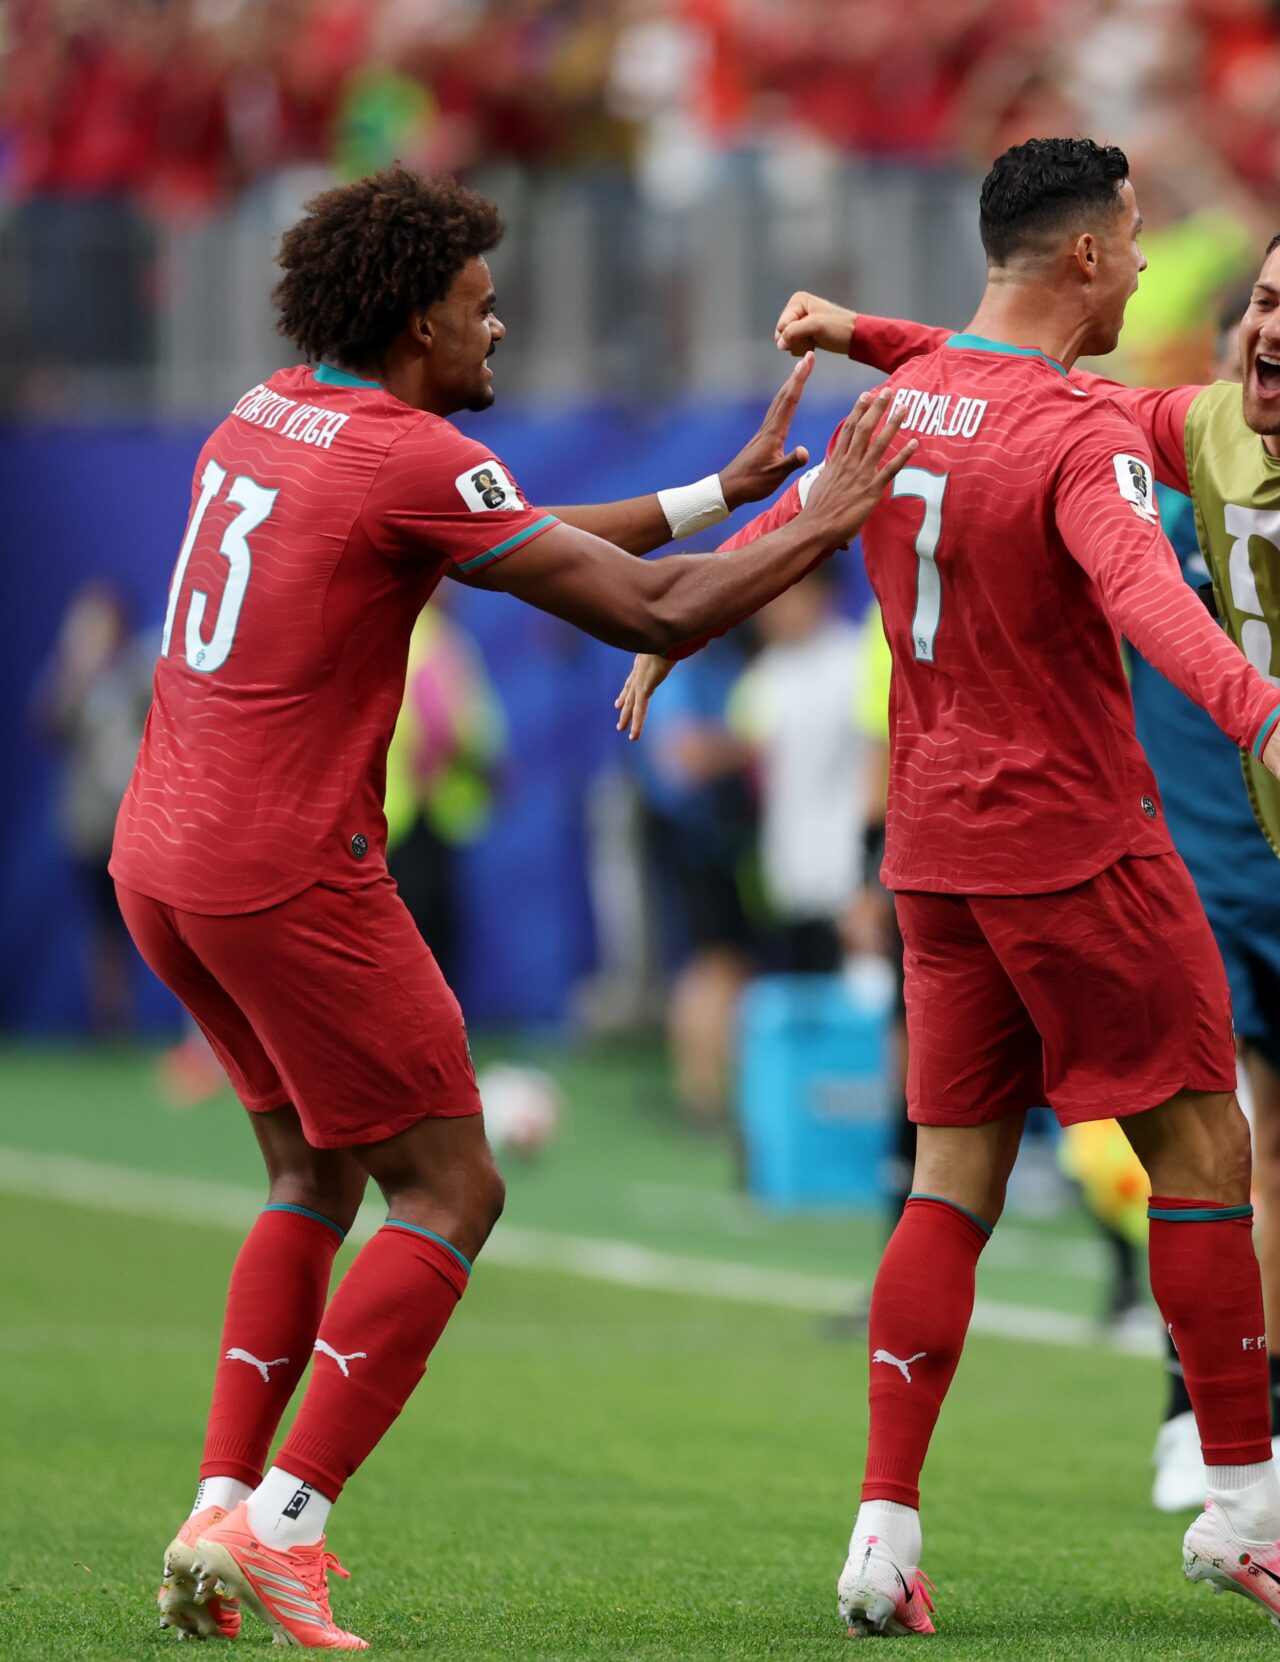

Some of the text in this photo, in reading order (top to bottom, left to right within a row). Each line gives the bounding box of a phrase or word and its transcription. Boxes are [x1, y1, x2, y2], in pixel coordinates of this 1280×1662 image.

[231, 384, 351, 449] ENATO VEIGA
[886, 388, 989, 438] RONALDO
[161, 459, 280, 674] 13
[891, 467, 949, 662] 7
